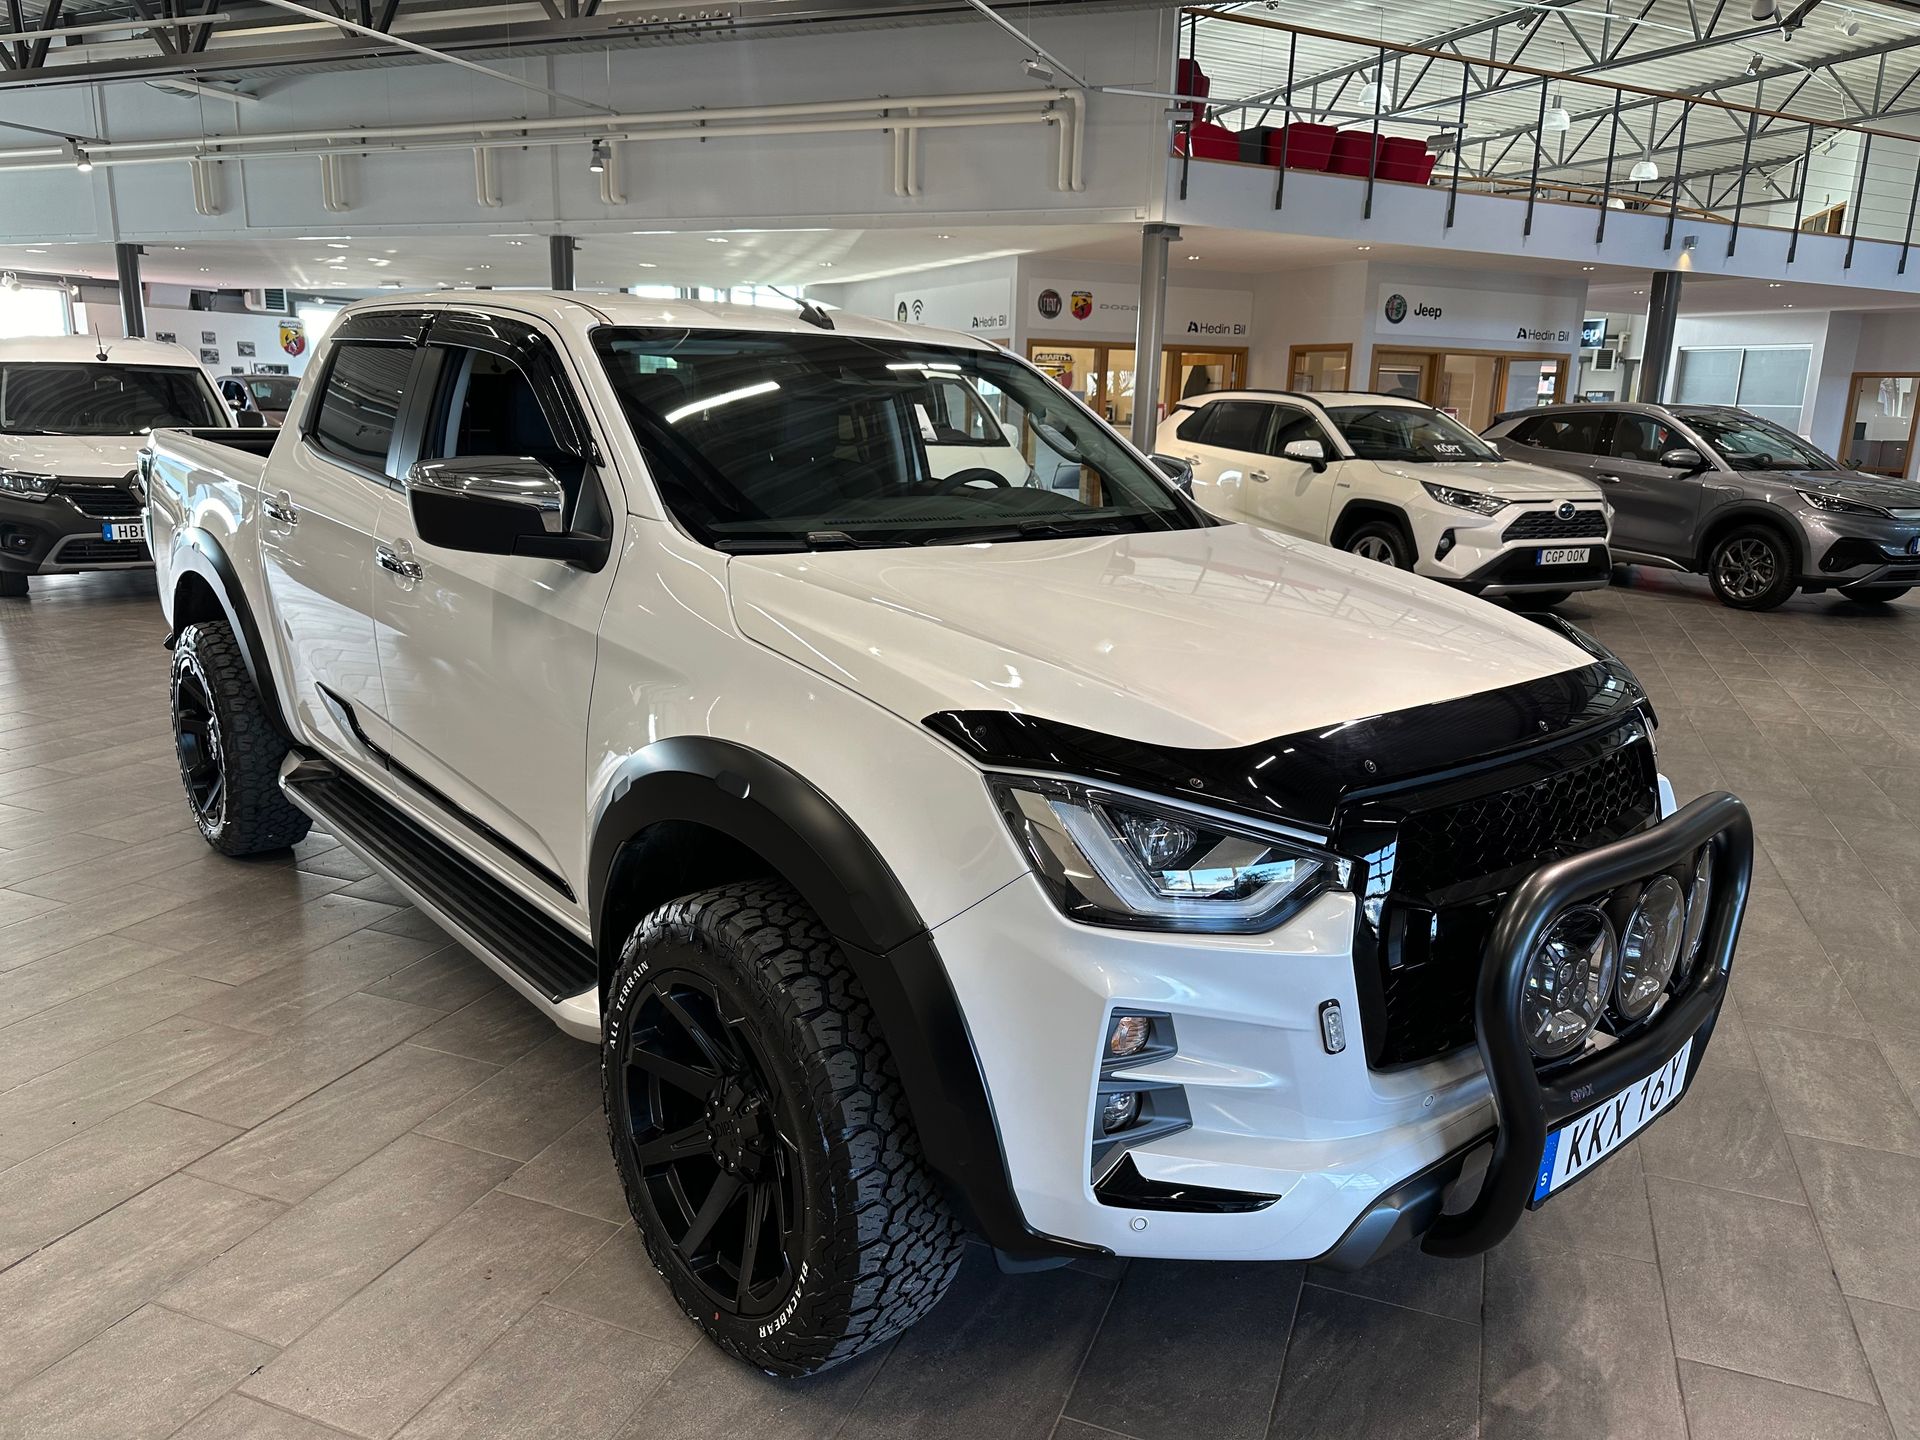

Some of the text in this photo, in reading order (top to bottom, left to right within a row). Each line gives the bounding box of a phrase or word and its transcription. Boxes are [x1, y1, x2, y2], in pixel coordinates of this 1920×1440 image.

[1414, 302, 1442, 320] Jeep
[979, 314, 1007, 328] Hedin Bil
[1200, 322, 1246, 335] Hedin Bil
[1528, 329, 1570, 342] Hedin Bil
[1581, 328, 1601, 342] ep
[1036, 353, 1071, 361] ABARTH
[1545, 550, 1565, 563] CGP
[609, 961, 650, 1050] ALL TERRAIN
[1565, 1048, 1685, 1176] KKX 16Y
[758, 1260, 809, 1338] BLACKBEAR
